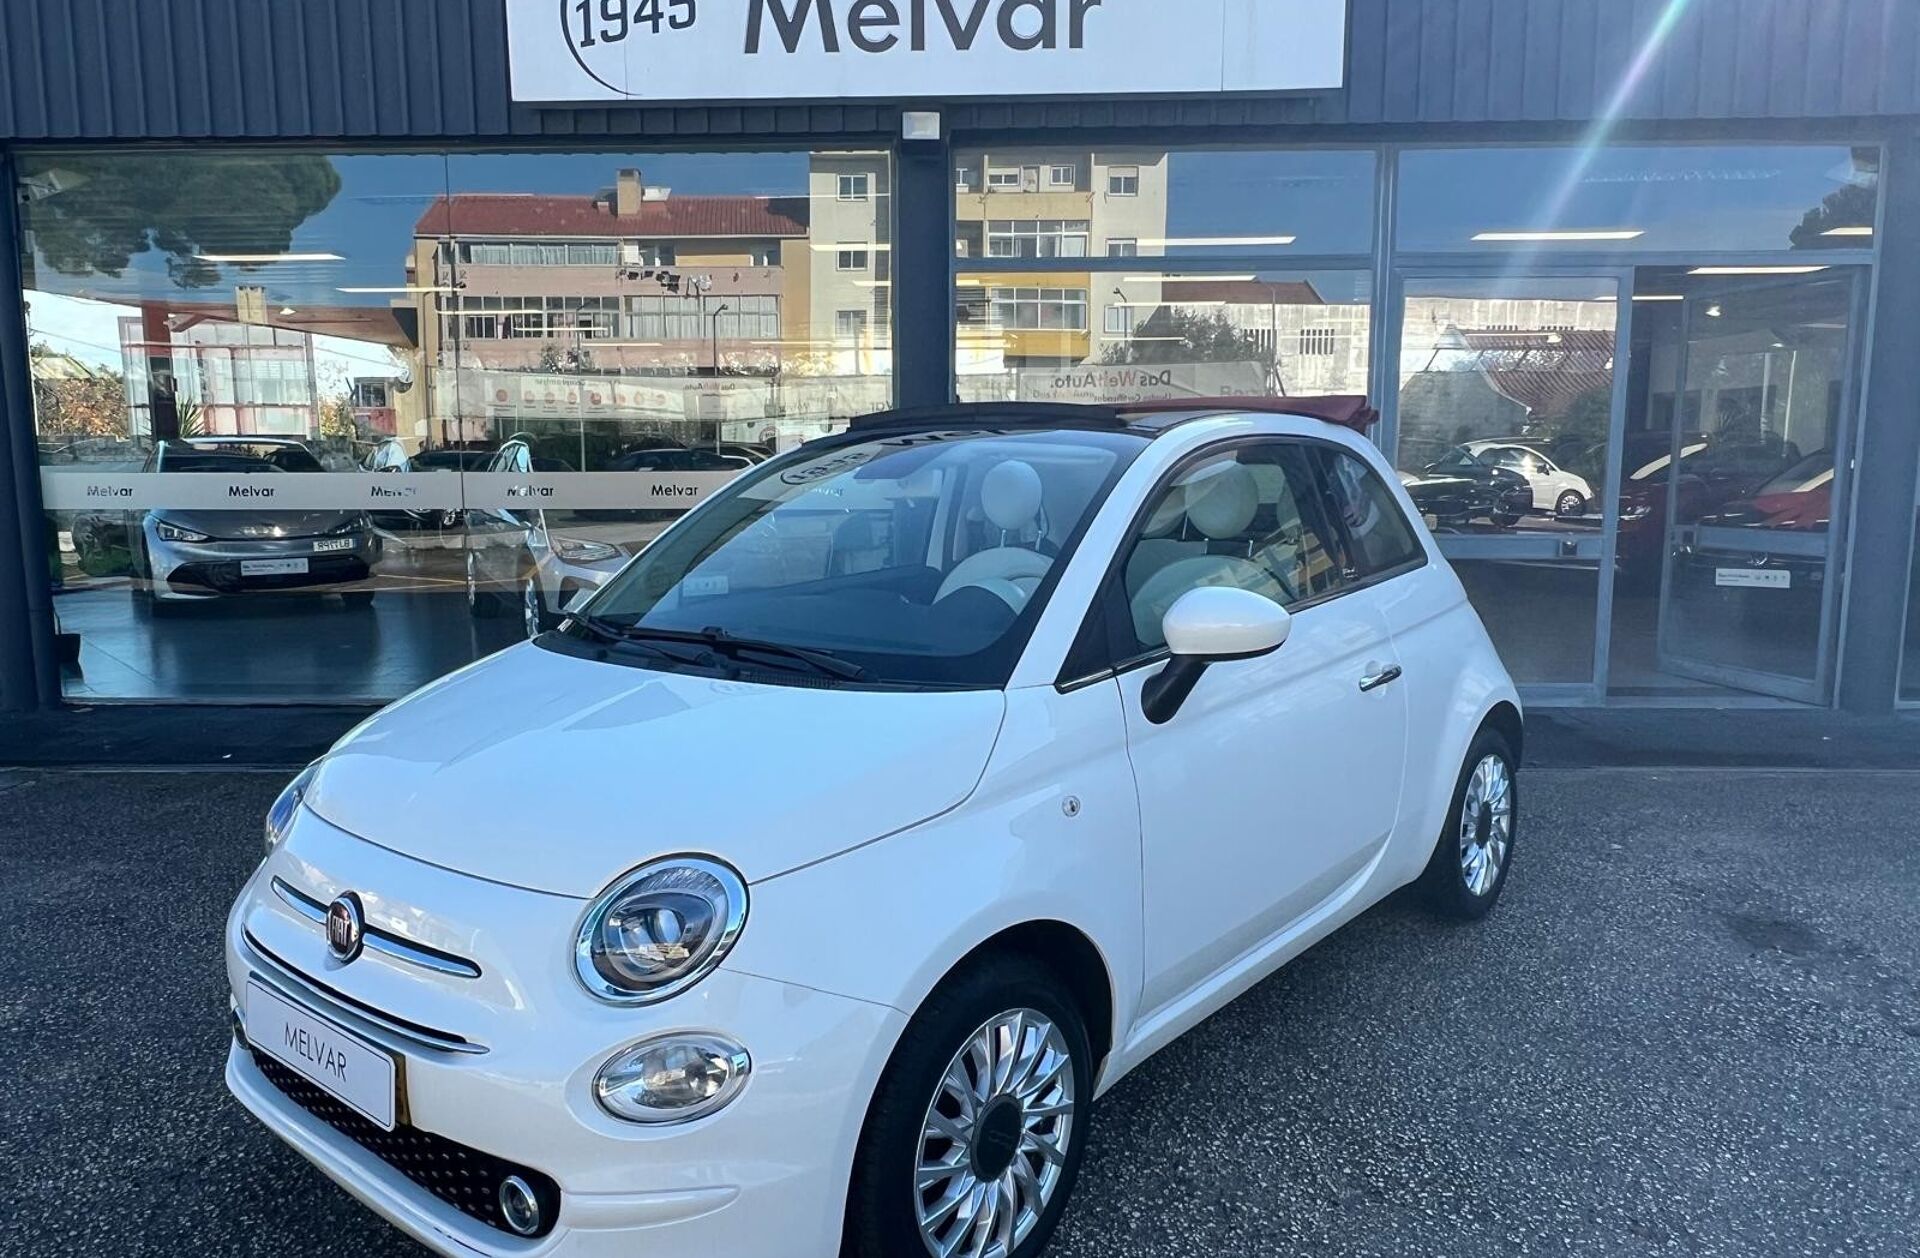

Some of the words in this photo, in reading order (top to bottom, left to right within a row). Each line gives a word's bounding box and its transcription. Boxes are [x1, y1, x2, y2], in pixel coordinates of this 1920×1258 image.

[575, 0, 697, 48] 1945
[744, 0, 1102, 54] Melvar
[87, 485, 133, 497] Melvar
[228, 485, 275, 497] Melvar
[651, 484, 698, 497] Melvar
[331, 915, 350, 947] FIAT
[284, 1021, 347, 1083] MELVAR
